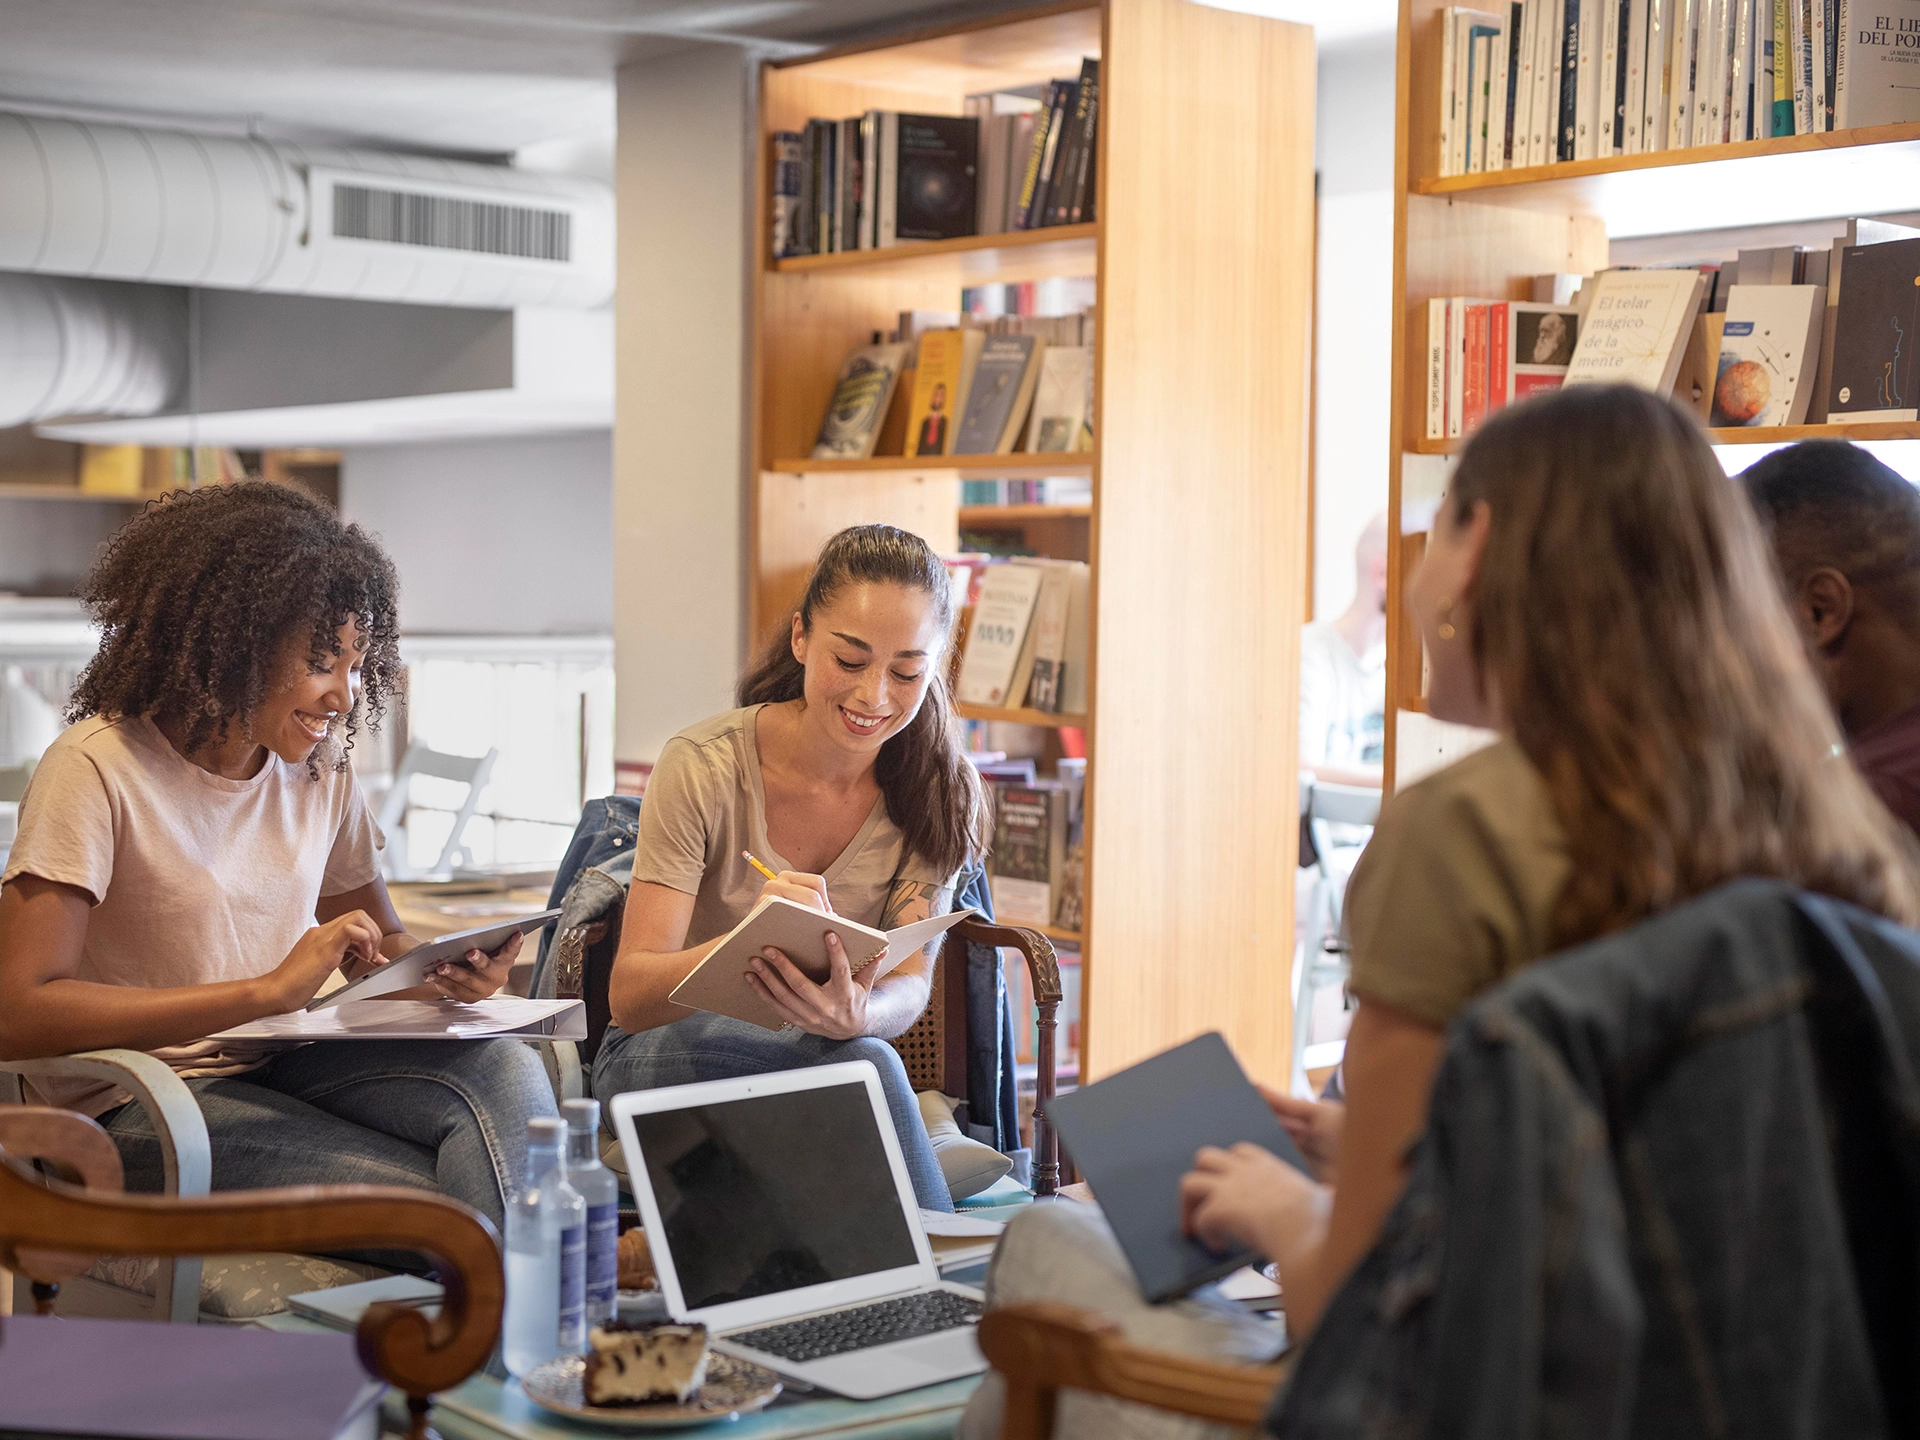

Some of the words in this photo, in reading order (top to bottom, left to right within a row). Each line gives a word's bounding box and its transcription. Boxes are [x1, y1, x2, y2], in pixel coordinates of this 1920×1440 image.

[1875, 16, 1894, 31] EL
[1568, 22, 1578, 57] TESLA
[1859, 31, 1890, 46] DEL
[1838, 44, 1846, 77] LIBRO
[1837, 79, 1844, 92] EL
[1599, 296, 1614, 309] El
[1616, 295, 1653, 310] telar
[1591, 315, 1644, 331] mágico
[1585, 335, 1602, 349] de
[1605, 335, 1618, 348] la
[1577, 355, 1624, 369] mente
